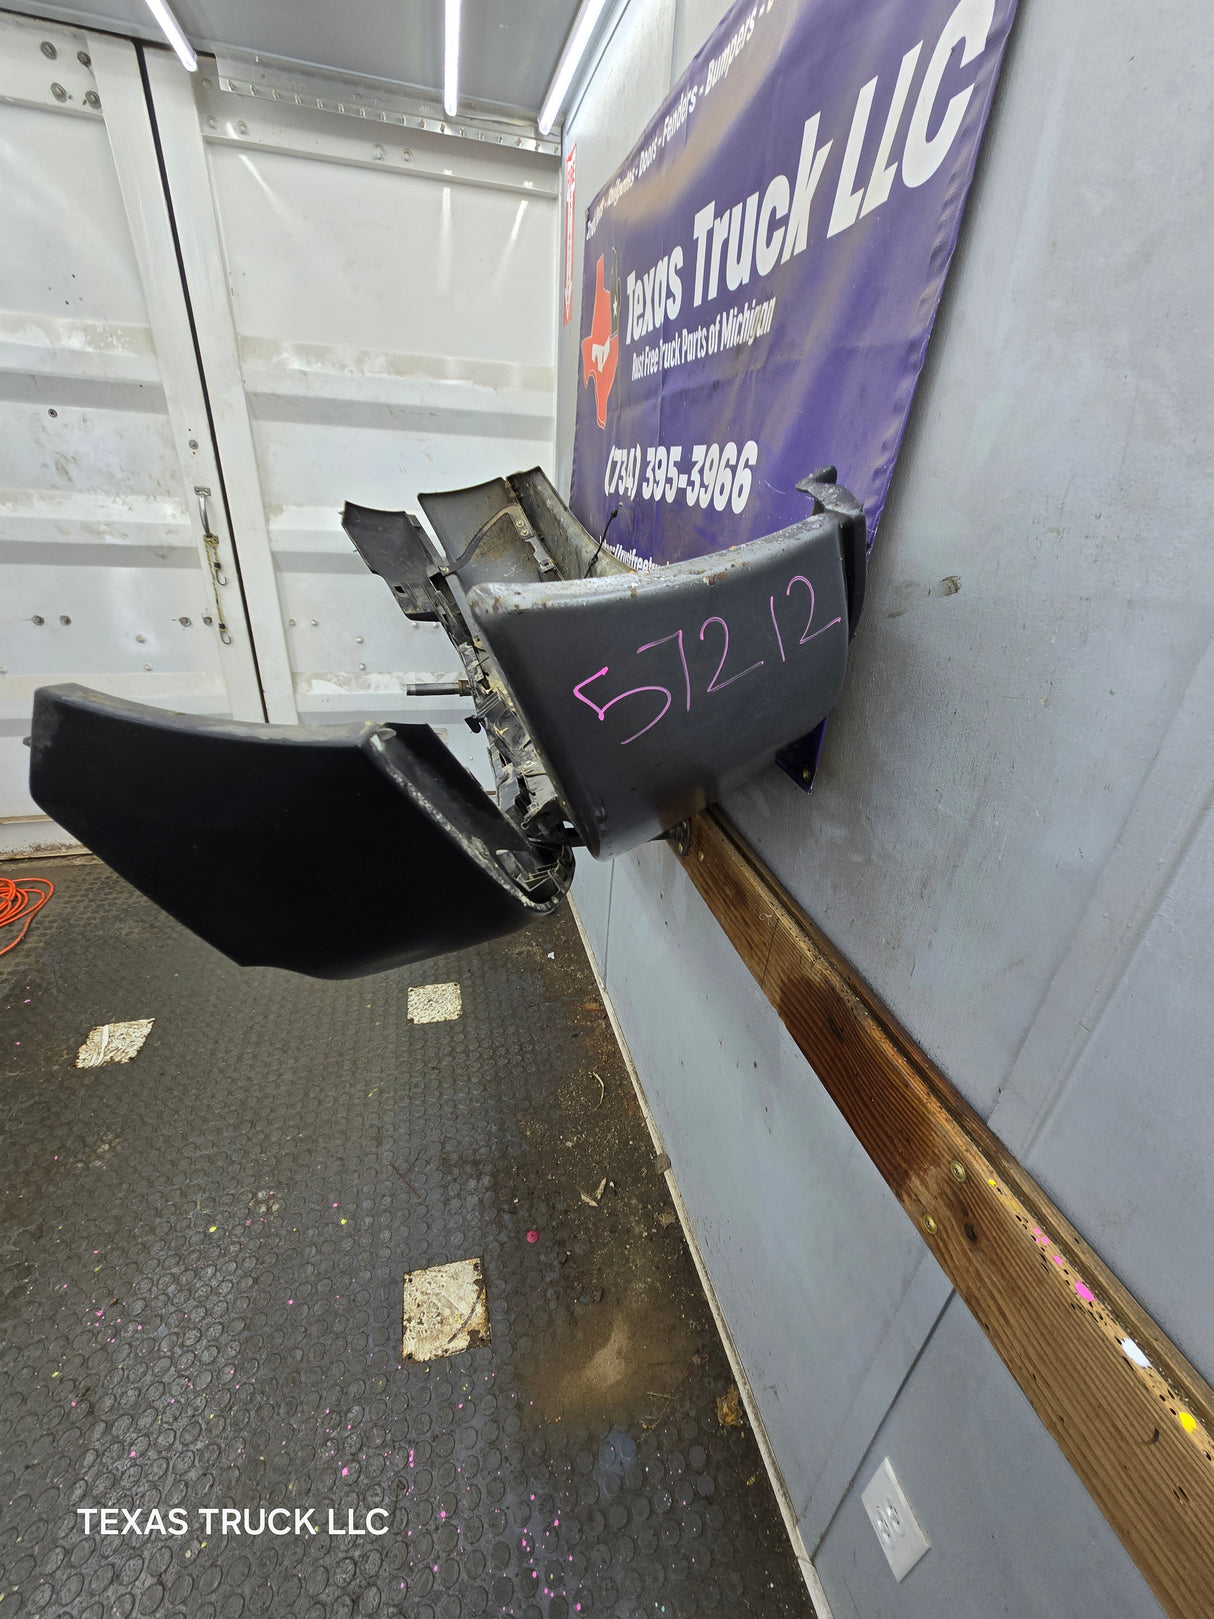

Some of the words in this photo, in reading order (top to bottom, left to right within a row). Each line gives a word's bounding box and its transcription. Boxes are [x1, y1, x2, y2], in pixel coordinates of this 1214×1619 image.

[661, 85, 698, 148] Fenders
[704, 7, 757, 97] Bumpers
[626, 247, 682, 346] Texas
[693, 111, 832, 308] Truck
[827, 0, 996, 238] LLC
[631, 352, 645, 381] Rust
[644, 345, 659, 376] Free
[659, 332, 681, 370] Truck
[682, 325, 707, 363] Parts
[708, 313, 720, 355] of
[720, 296, 777, 351] Michigan
[605, 444, 640, 500] (734)
[643, 441, 758, 514] 395-3966
